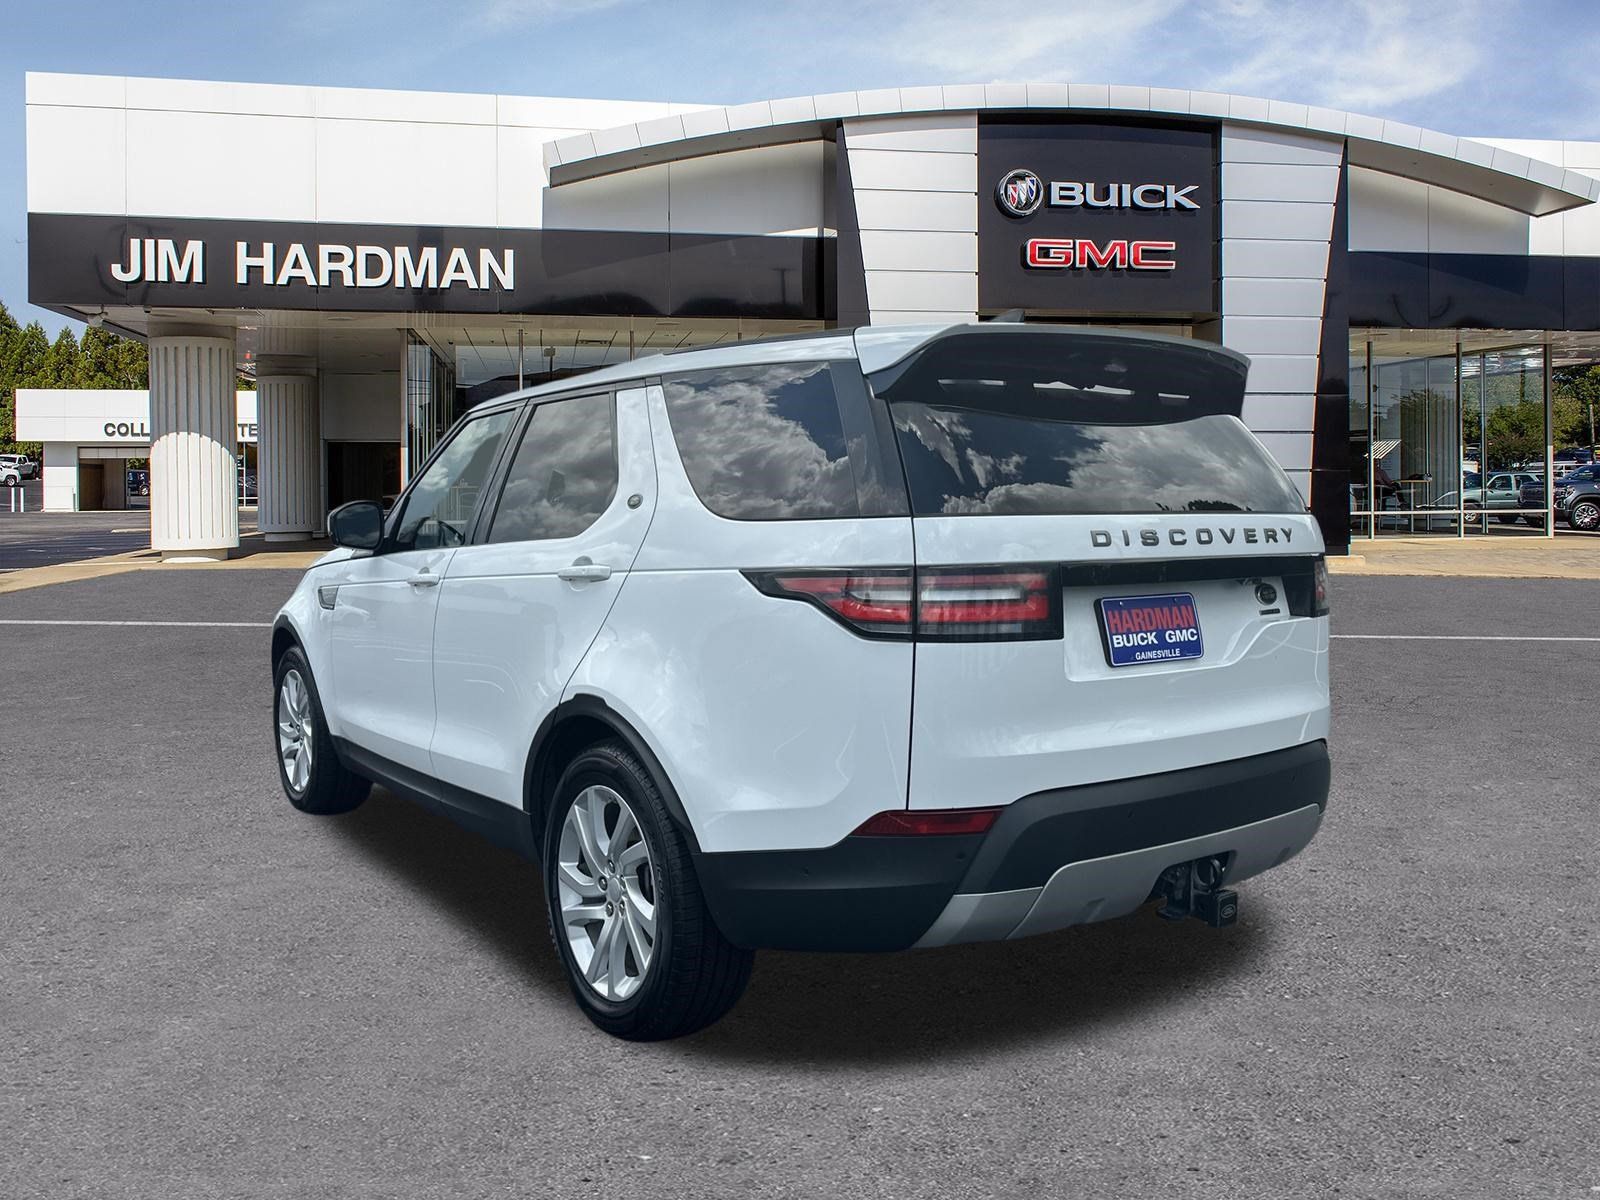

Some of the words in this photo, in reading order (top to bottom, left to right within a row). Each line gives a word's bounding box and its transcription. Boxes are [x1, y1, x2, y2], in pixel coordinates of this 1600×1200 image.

[1049, 181, 1201, 209] BUICK
[110, 238, 205, 284] JIM
[235, 241, 516, 290] HARDMAN
[1025, 238, 1176, 270] GMC
[1090, 527, 1293, 548] DISCOVERY
[1107, 605, 1196, 634] HARDMAN
[1112, 631, 1159, 648] BUICK
[1165, 628, 1198, 643] GMC
[1135, 648, 1181, 660] GAINESVILLE
